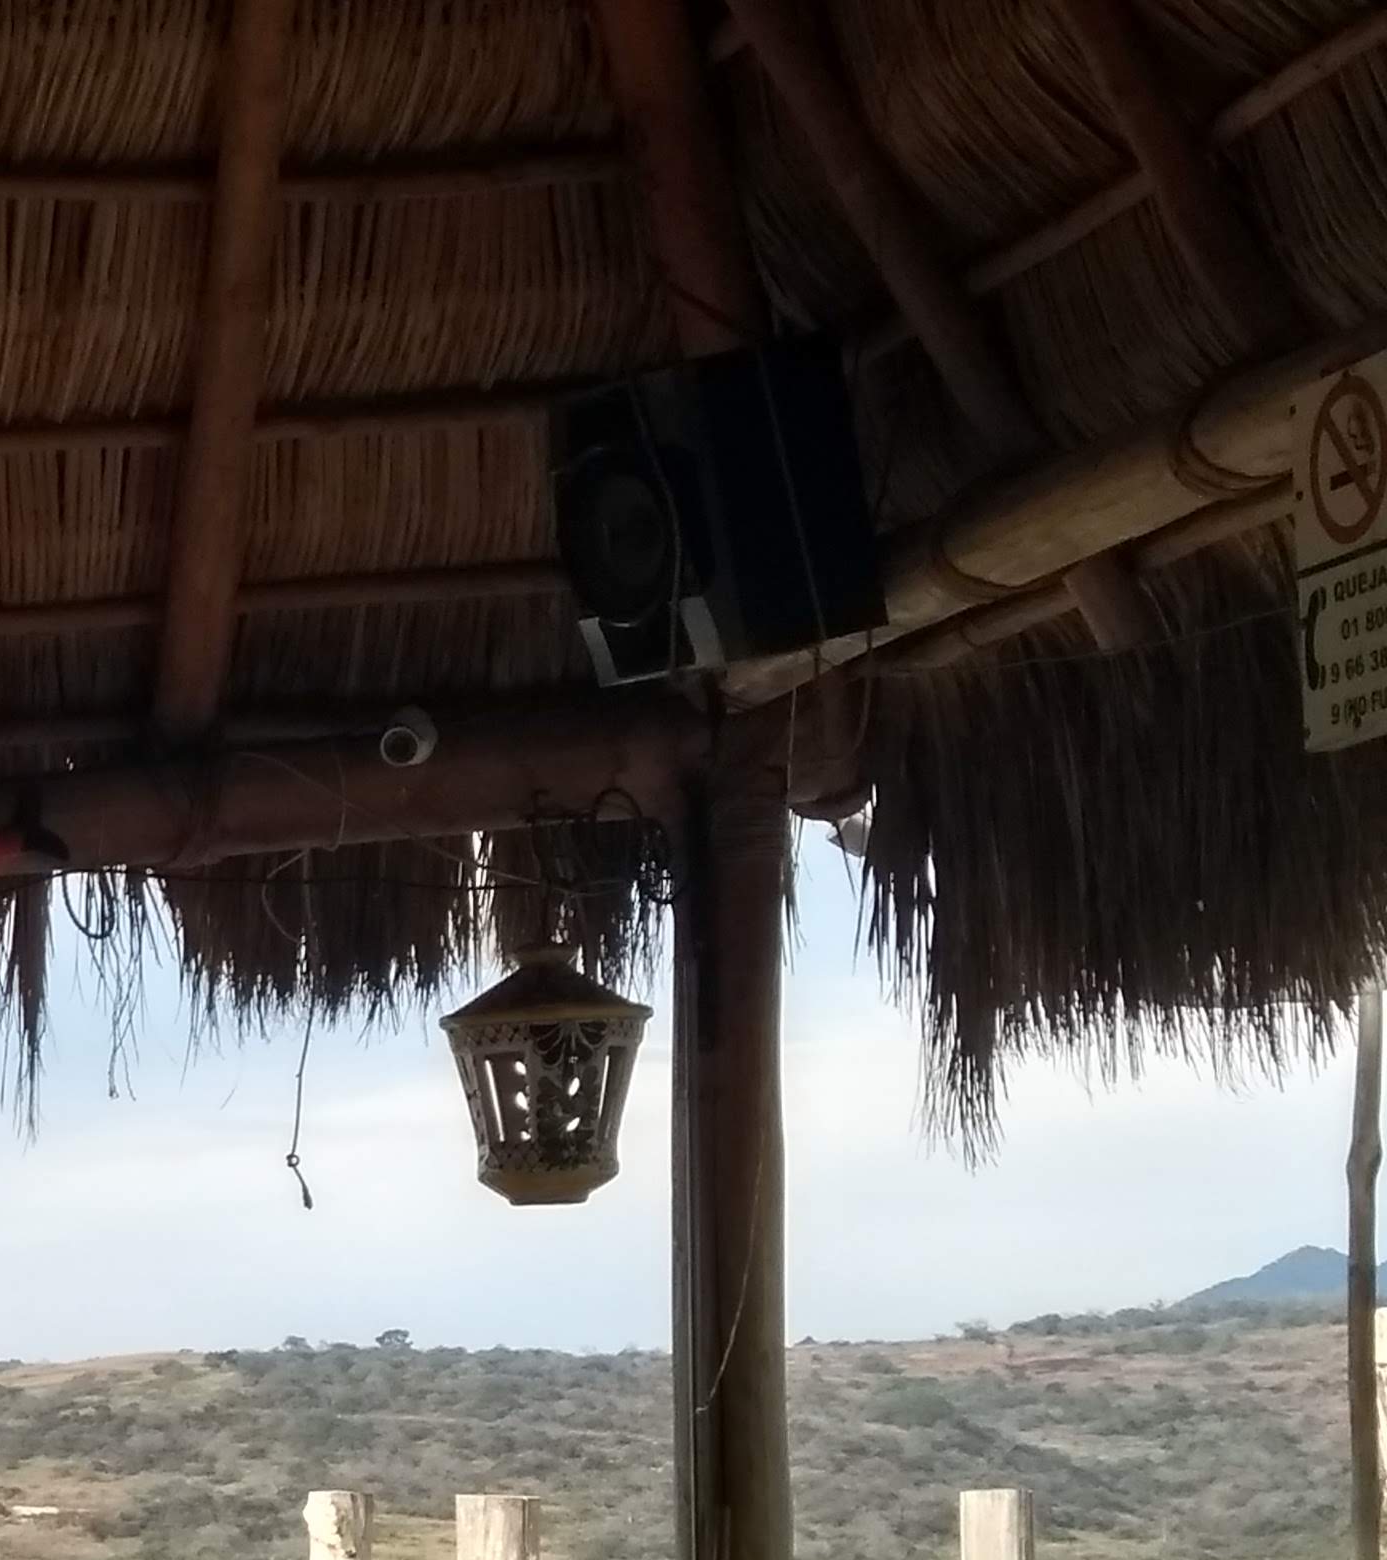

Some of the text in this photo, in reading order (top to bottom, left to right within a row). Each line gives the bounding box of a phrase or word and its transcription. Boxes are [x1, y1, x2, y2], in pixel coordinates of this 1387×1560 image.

[1342, 606, 1387, 640] 01 80
[1331, 662, 1340, 683] 9
